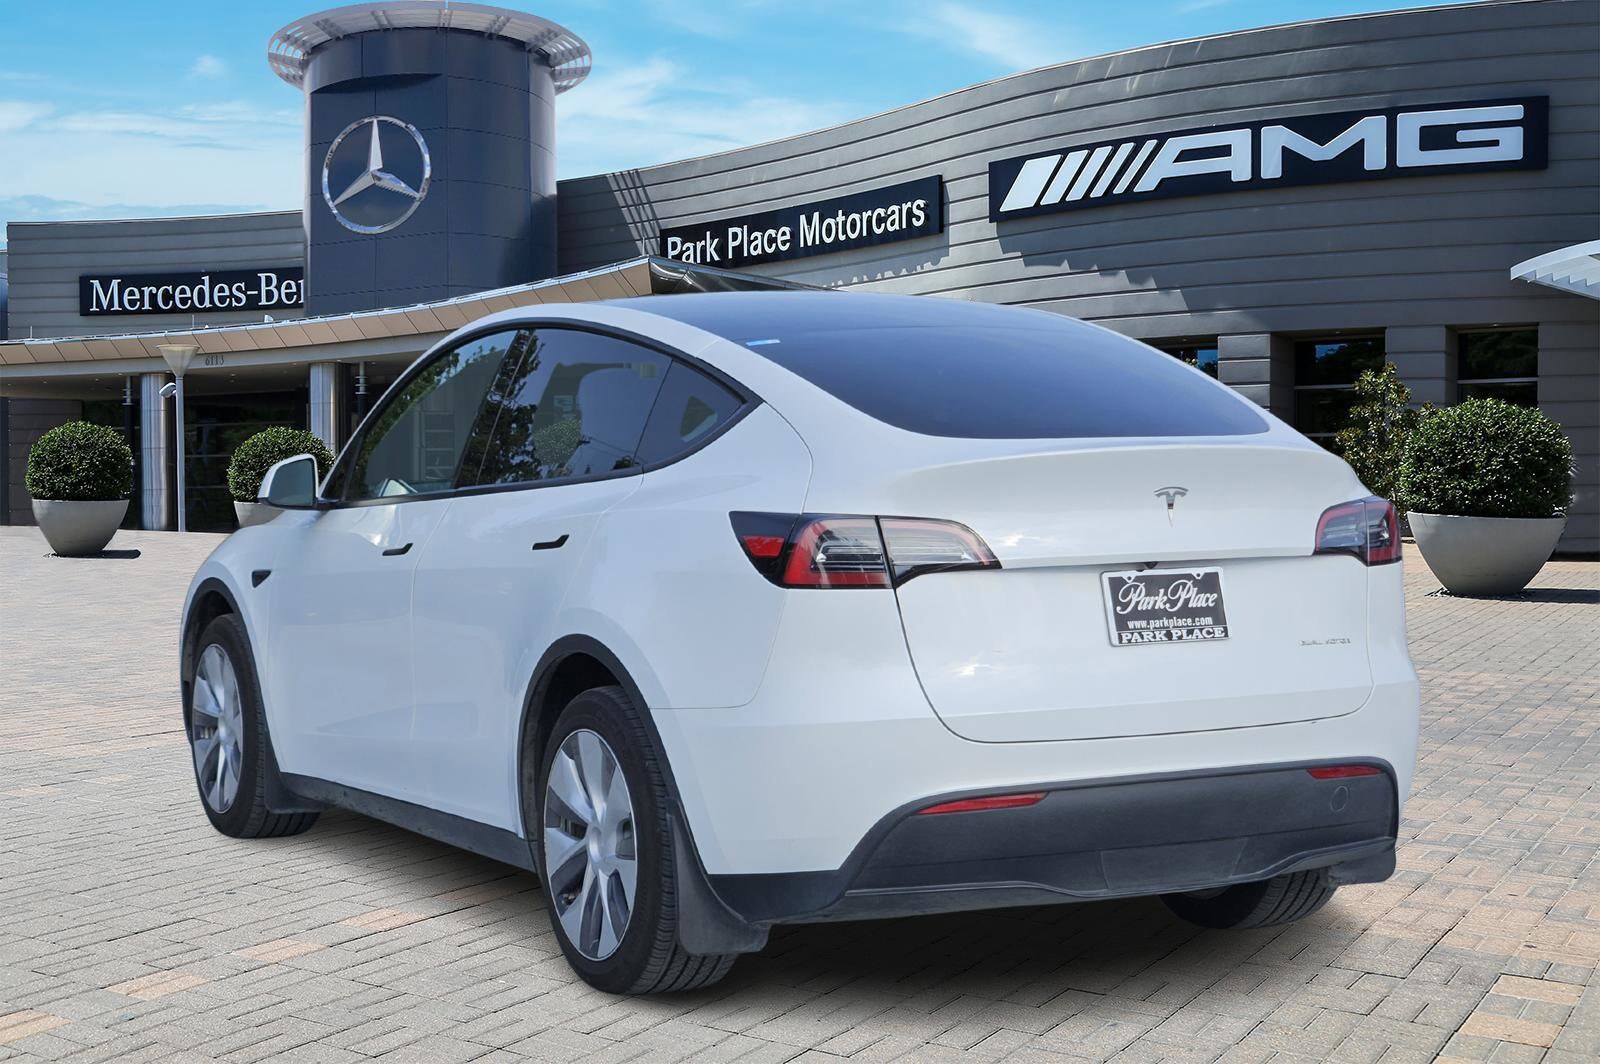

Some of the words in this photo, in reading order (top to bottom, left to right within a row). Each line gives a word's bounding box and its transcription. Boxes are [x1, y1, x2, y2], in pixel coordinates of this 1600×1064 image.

[667, 231, 720, 263] Park
[728, 225, 791, 259] Place
[799, 198, 926, 248] Motorcars
[1116, 582, 1168, 615] Park
[1165, 579, 1218, 612] Place
[1121, 630, 1168, 643] PARK
[1170, 627, 1225, 641] PLACE
[1127, 616, 1213, 630] www.parkplace.com
